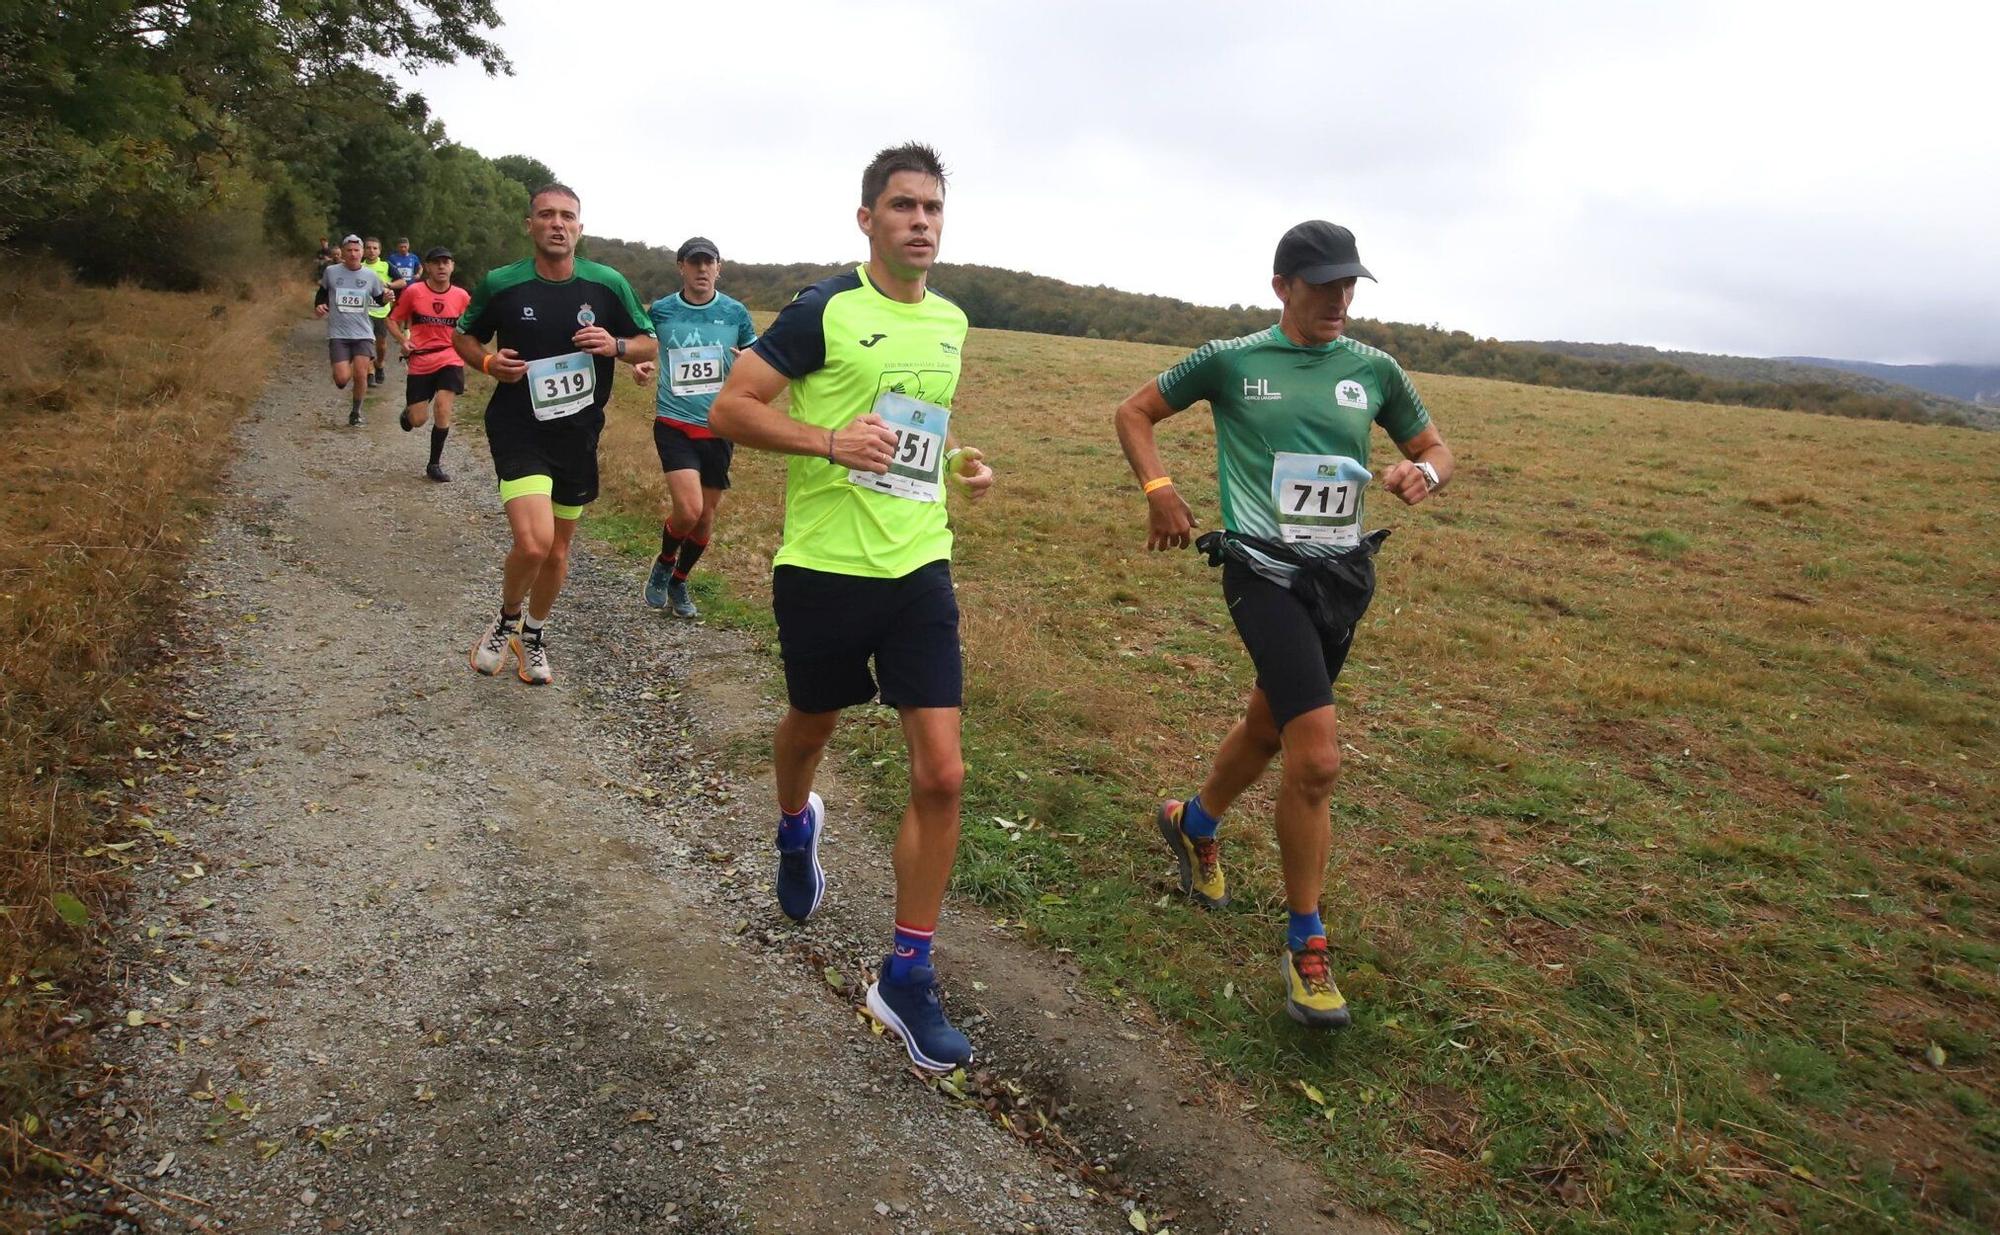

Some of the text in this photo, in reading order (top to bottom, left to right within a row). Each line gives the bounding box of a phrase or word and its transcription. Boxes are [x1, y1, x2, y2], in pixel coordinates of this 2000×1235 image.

[341, 296, 360, 305] 826
[681, 362, 713, 379] 785
[544, 373, 585, 398] 319
[1243, 378, 1281, 396] HL
[1293, 484, 1348, 514] 717
